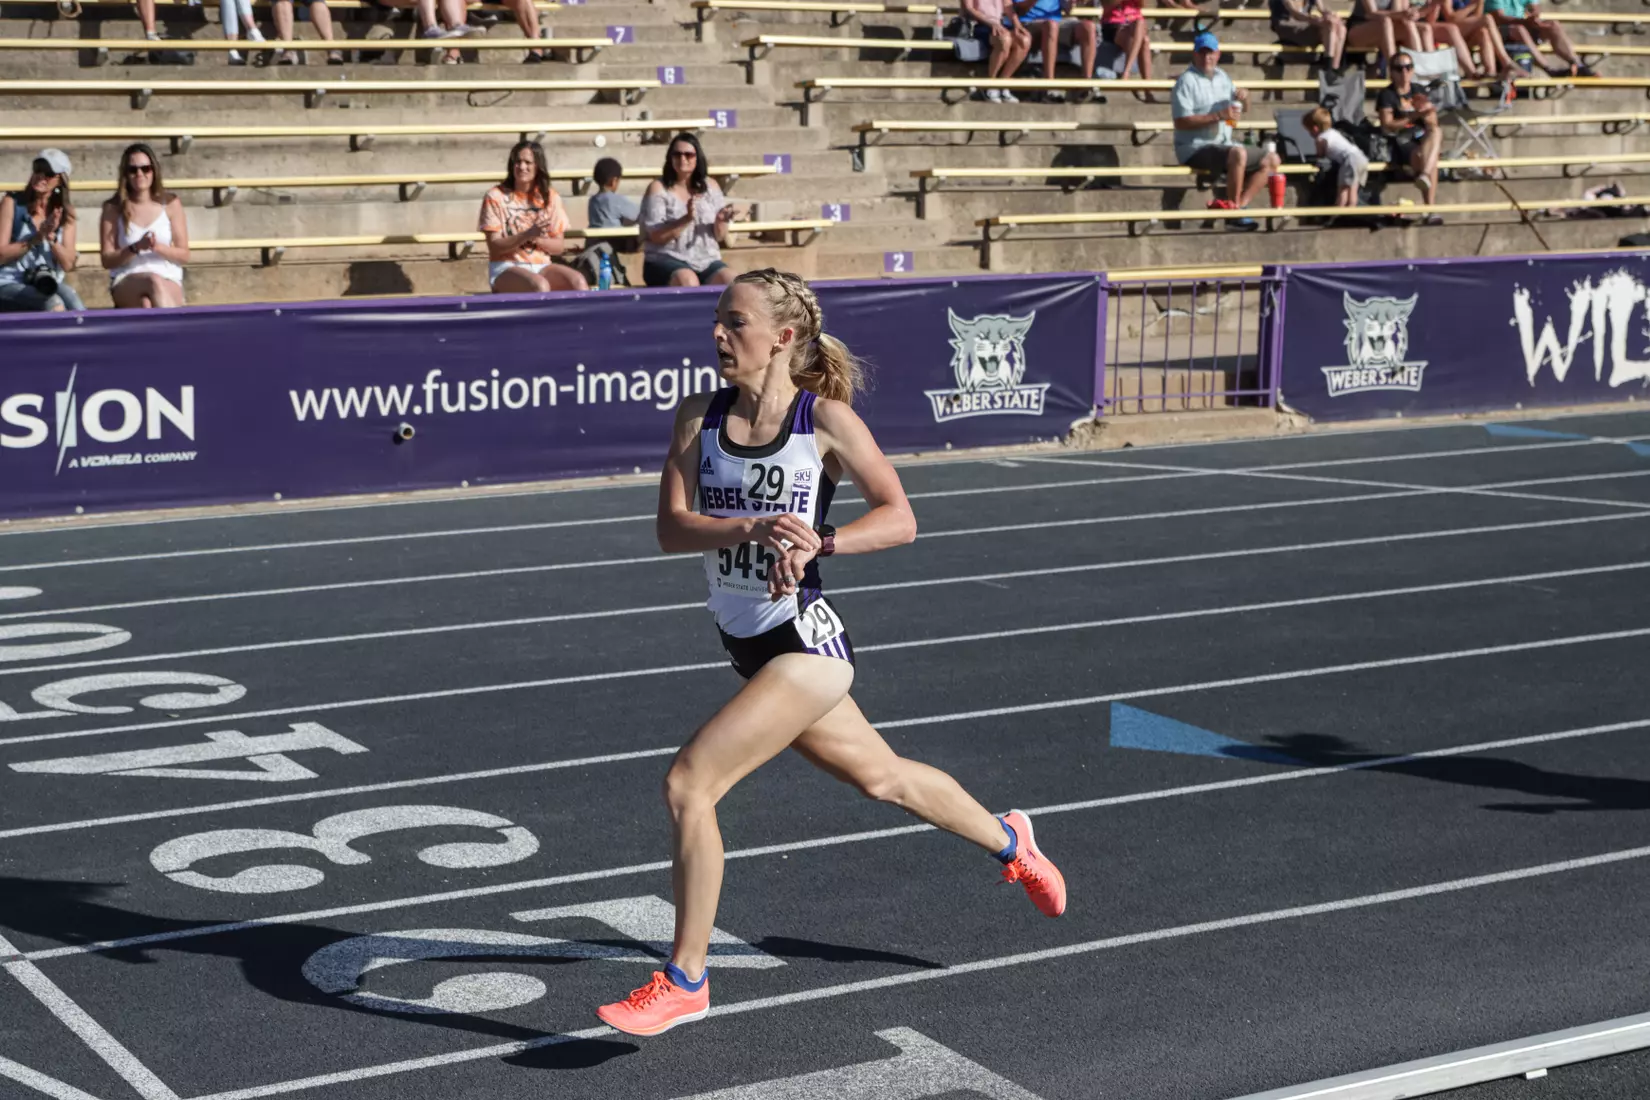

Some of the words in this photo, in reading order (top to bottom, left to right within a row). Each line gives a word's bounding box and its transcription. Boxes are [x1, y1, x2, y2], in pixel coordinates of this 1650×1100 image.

[615, 27, 625, 43] 7
[664, 67, 675, 84] 6
[716, 111, 727, 128] 5
[773, 156, 783, 173] 4
[830, 204, 841, 222] 3
[893, 254, 904, 271] 2
[1509, 268, 1650, 389] WIL
[289, 357, 728, 421] www.fusion-imagin
[1331, 369, 1377, 391] WEBER
[993, 389, 1040, 409] STATE
[144, 451, 197, 464] COMPANY
[747, 463, 785, 501] 29
[802, 604, 836, 646] 29
